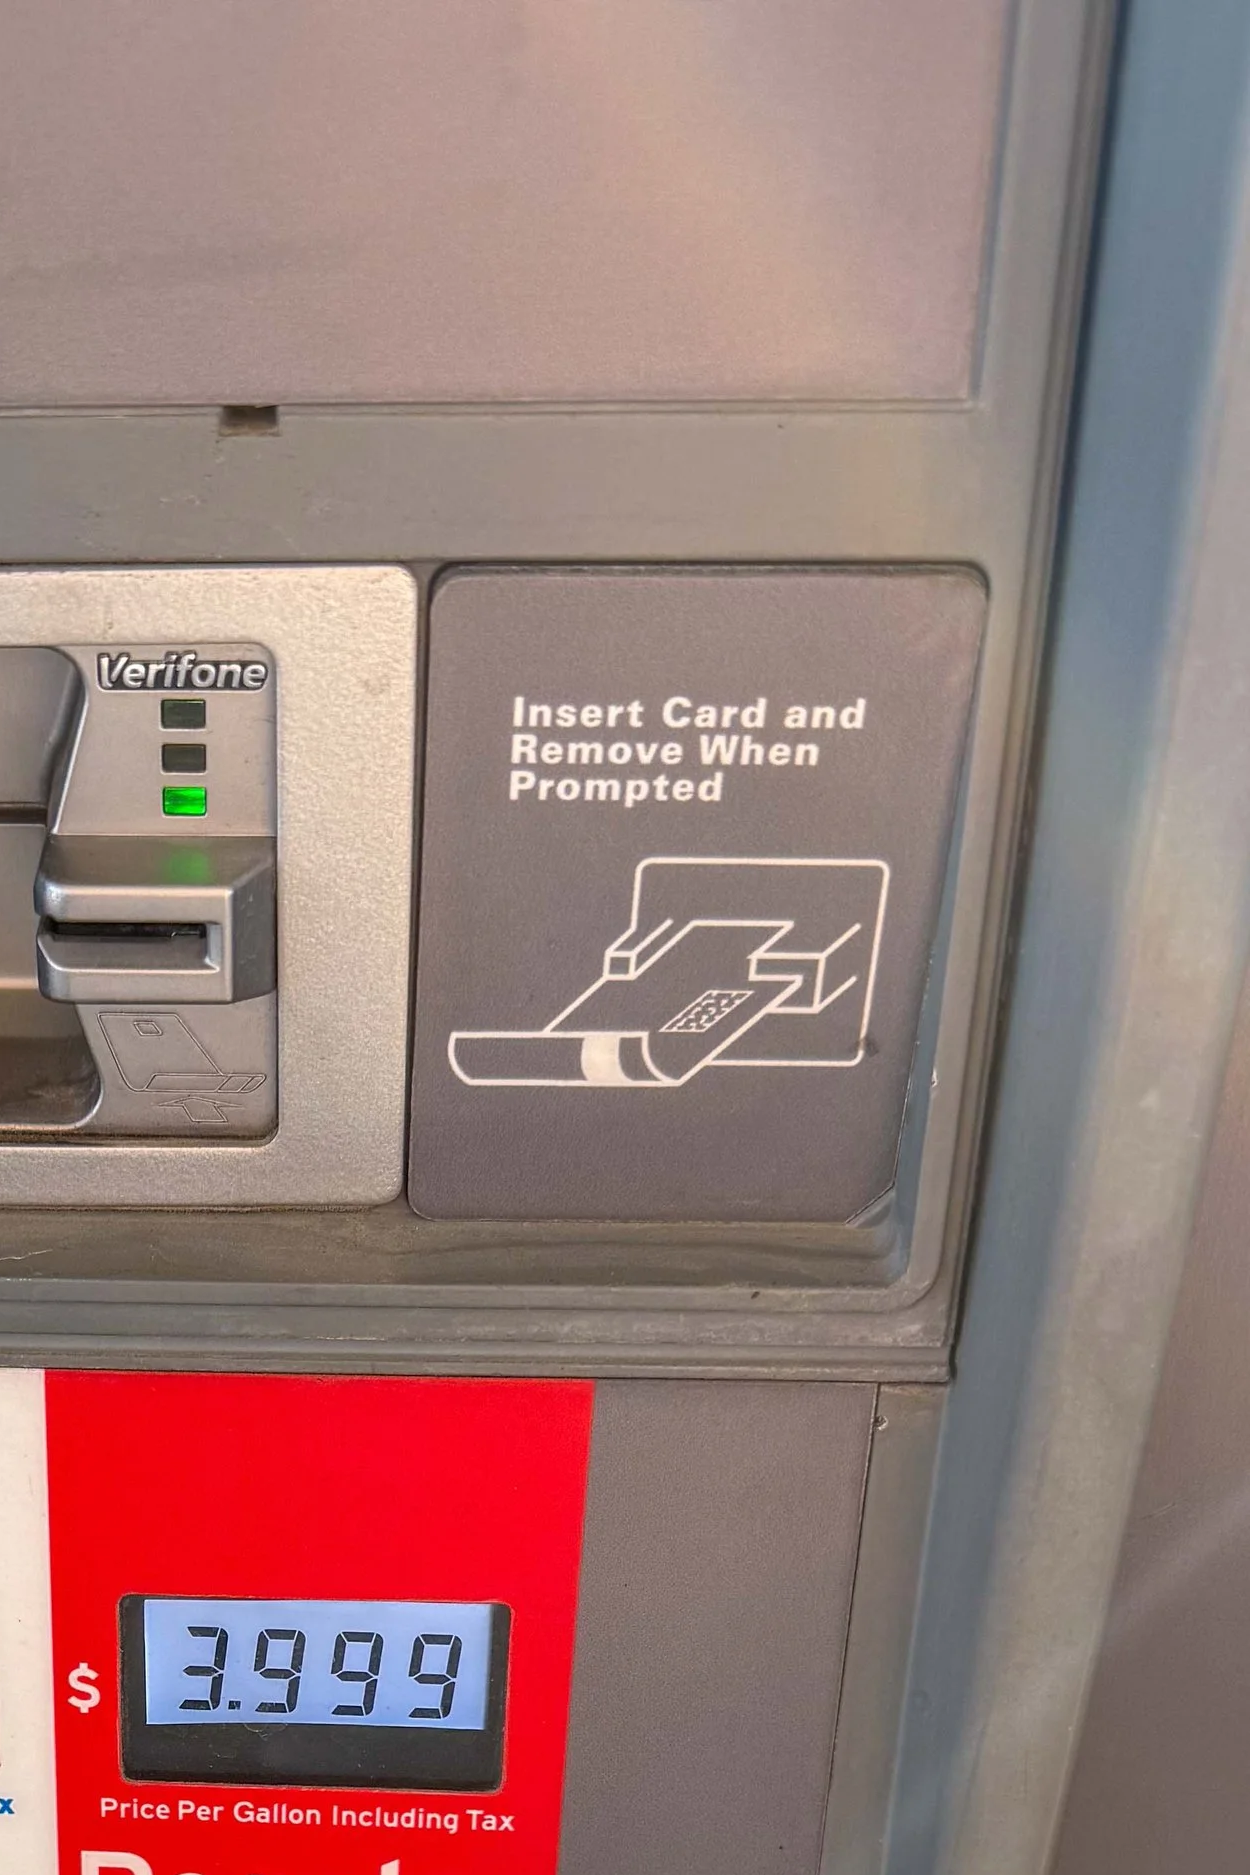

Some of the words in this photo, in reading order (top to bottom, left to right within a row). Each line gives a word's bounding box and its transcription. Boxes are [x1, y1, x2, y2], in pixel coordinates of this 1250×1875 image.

[99, 652, 266, 689] Verifone
[513, 696, 644, 728] Insert
[662, 696, 767, 729] Card
[783, 697, 867, 730] and
[511, 733, 683, 765] Remove
[699, 734, 820, 766] When
[509, 770, 724, 808] Prompted
[67, 1662, 101, 1714] $
[178, 1624, 463, 1720] 3.999
[100, 1797, 171, 1820] Price
[178, 1799, 224, 1822] Per
[233, 1801, 321, 1825] Gallon
[332, 1805, 459, 1835] Including
[465, 1809, 514, 1831] Tax
